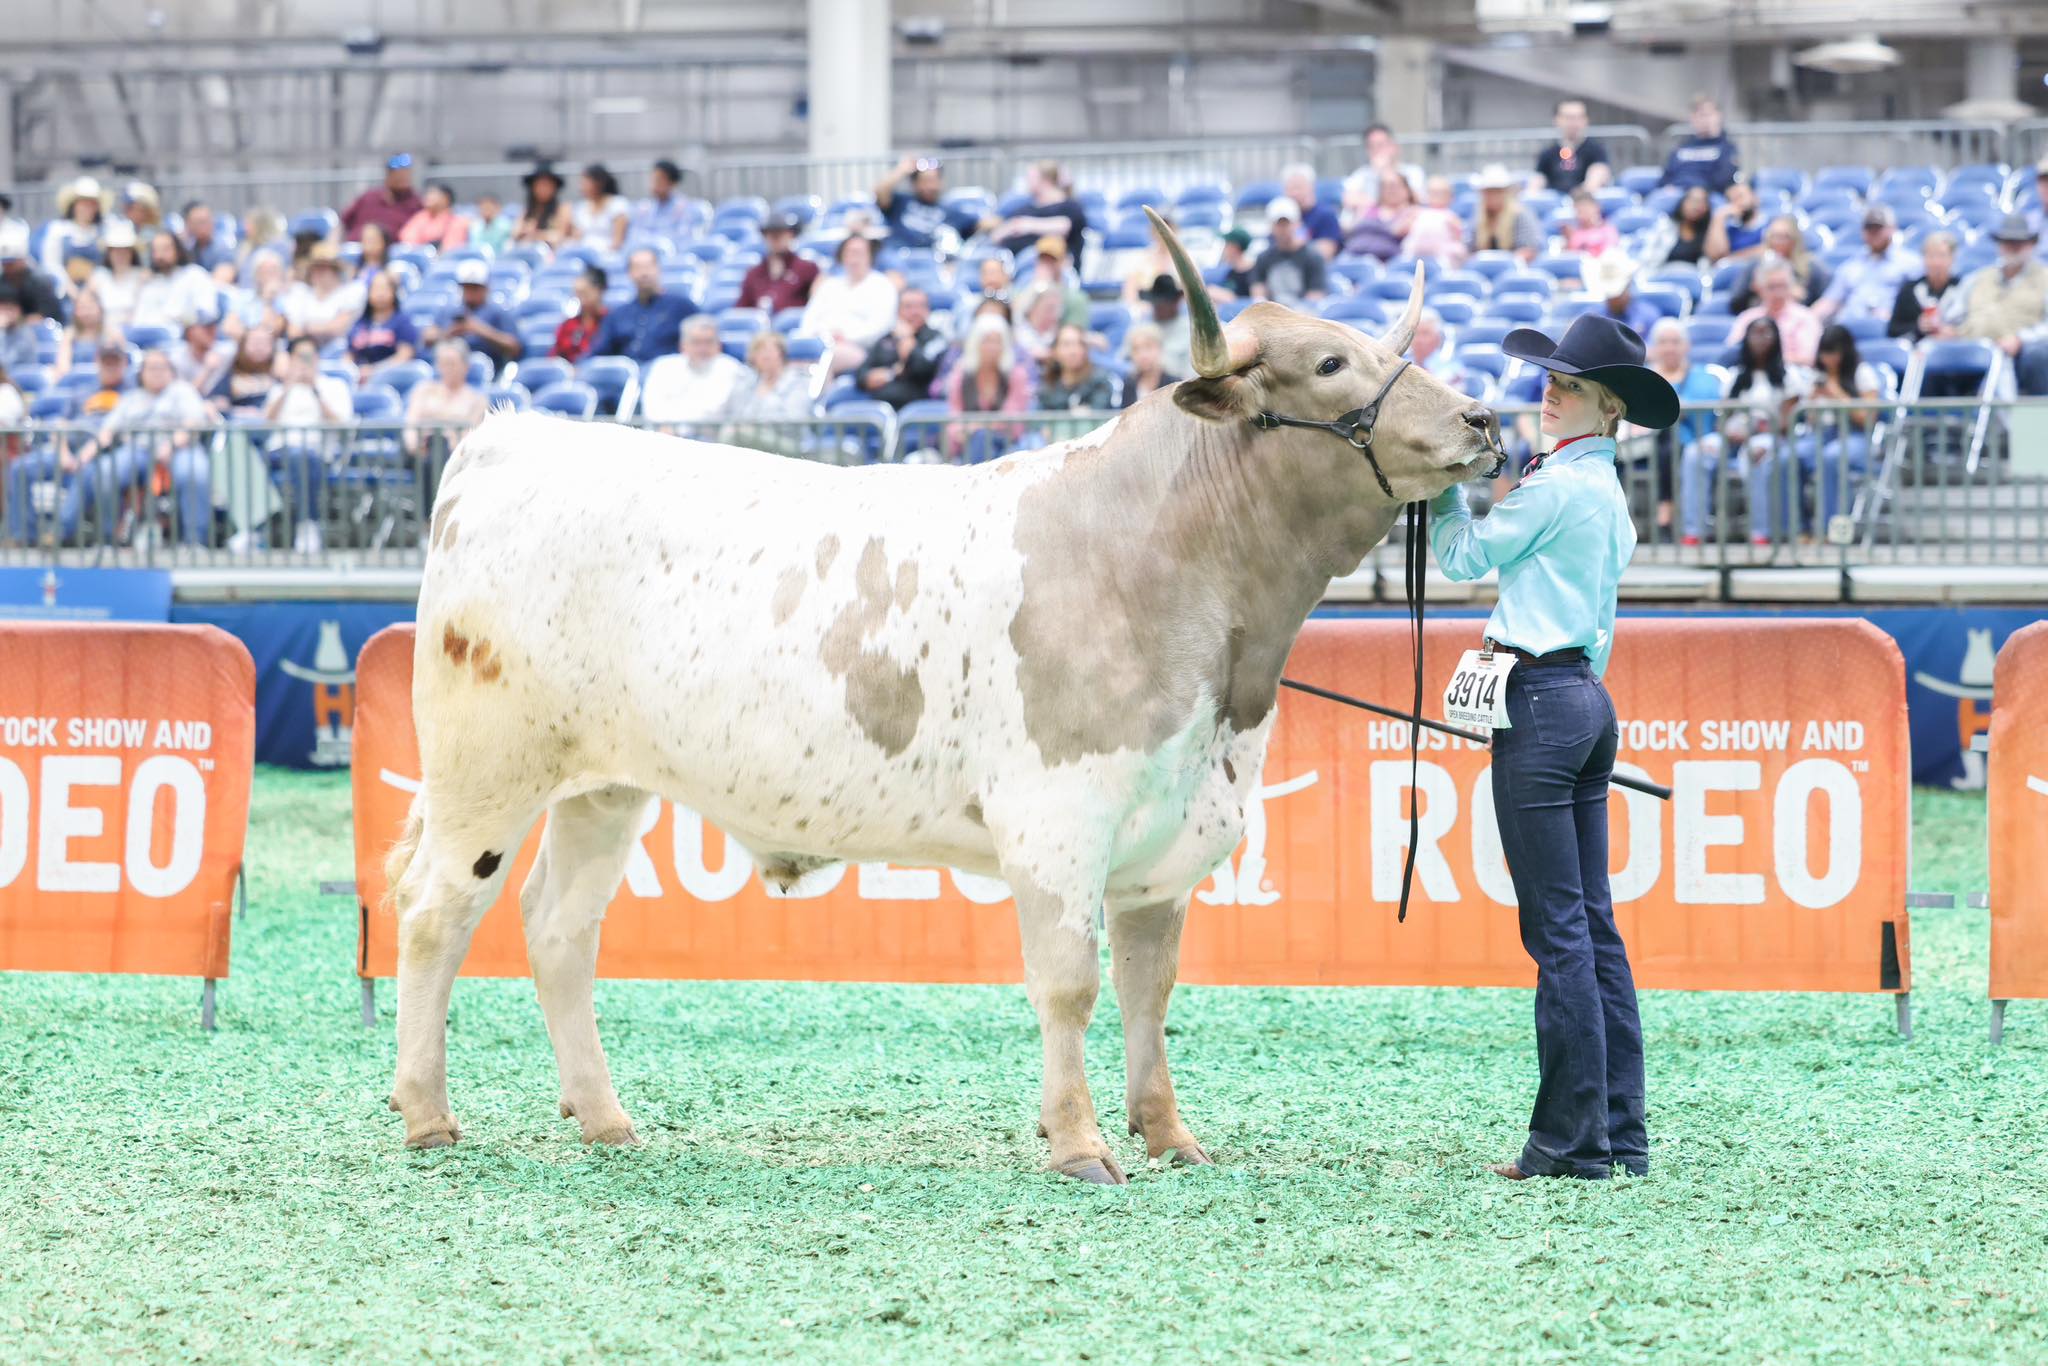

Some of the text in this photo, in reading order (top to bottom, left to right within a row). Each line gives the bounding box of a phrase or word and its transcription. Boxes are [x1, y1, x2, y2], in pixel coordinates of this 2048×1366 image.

[1447, 670, 1499, 711] 3914
[0, 716, 212, 750] OCK SHOW AND
[1617, 719, 1690, 751] TOCK
[1700, 720, 1791, 751] SHOW
[1801, 720, 1864, 751] AND
